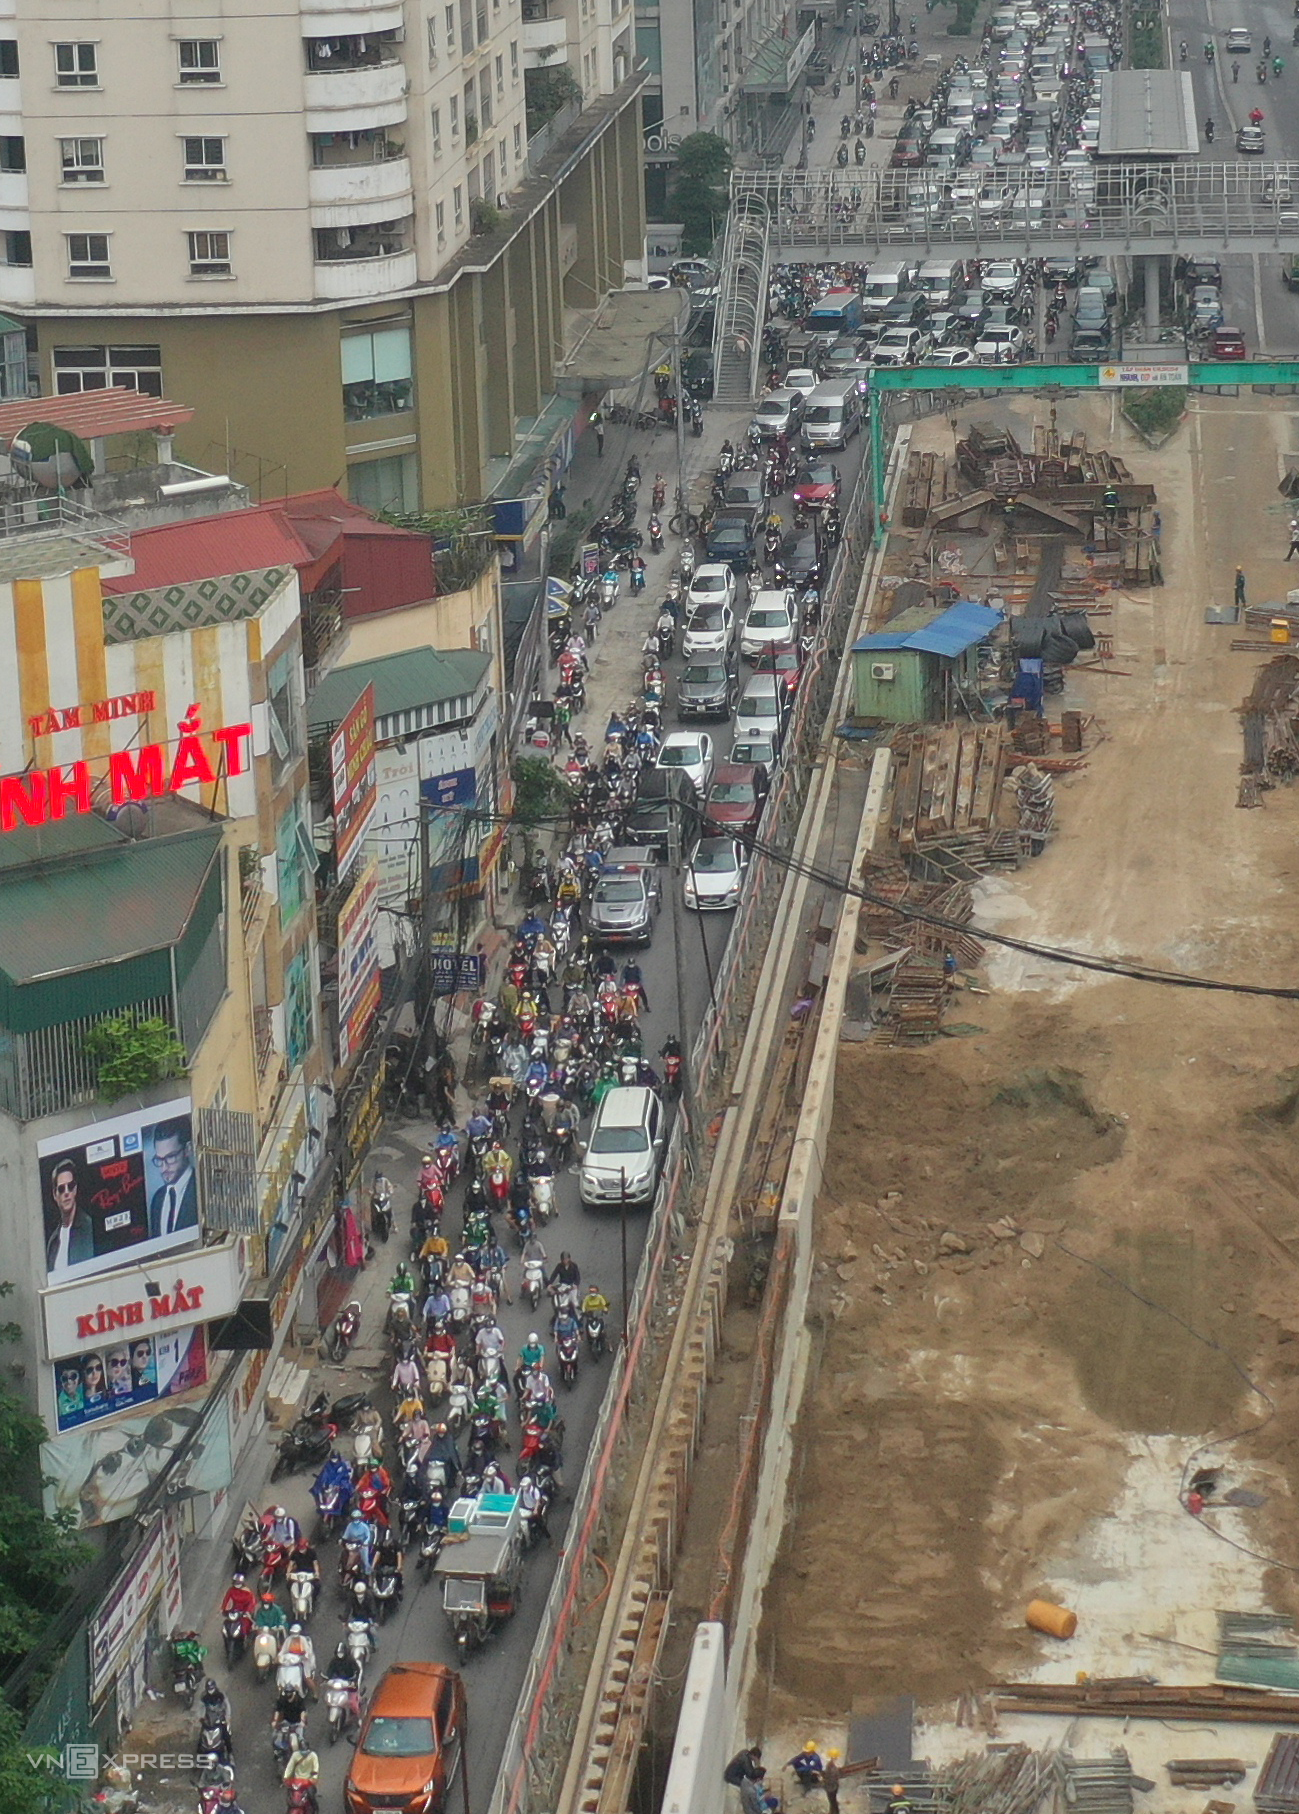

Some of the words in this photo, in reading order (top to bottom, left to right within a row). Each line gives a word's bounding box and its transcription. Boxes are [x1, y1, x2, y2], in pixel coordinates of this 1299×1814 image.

[92, 691, 155, 723] MINH
[110, 702, 253, 805] MẮT
[76, 1303, 144, 1339] KÍNH
[149, 1279, 204, 1320] MẮT
